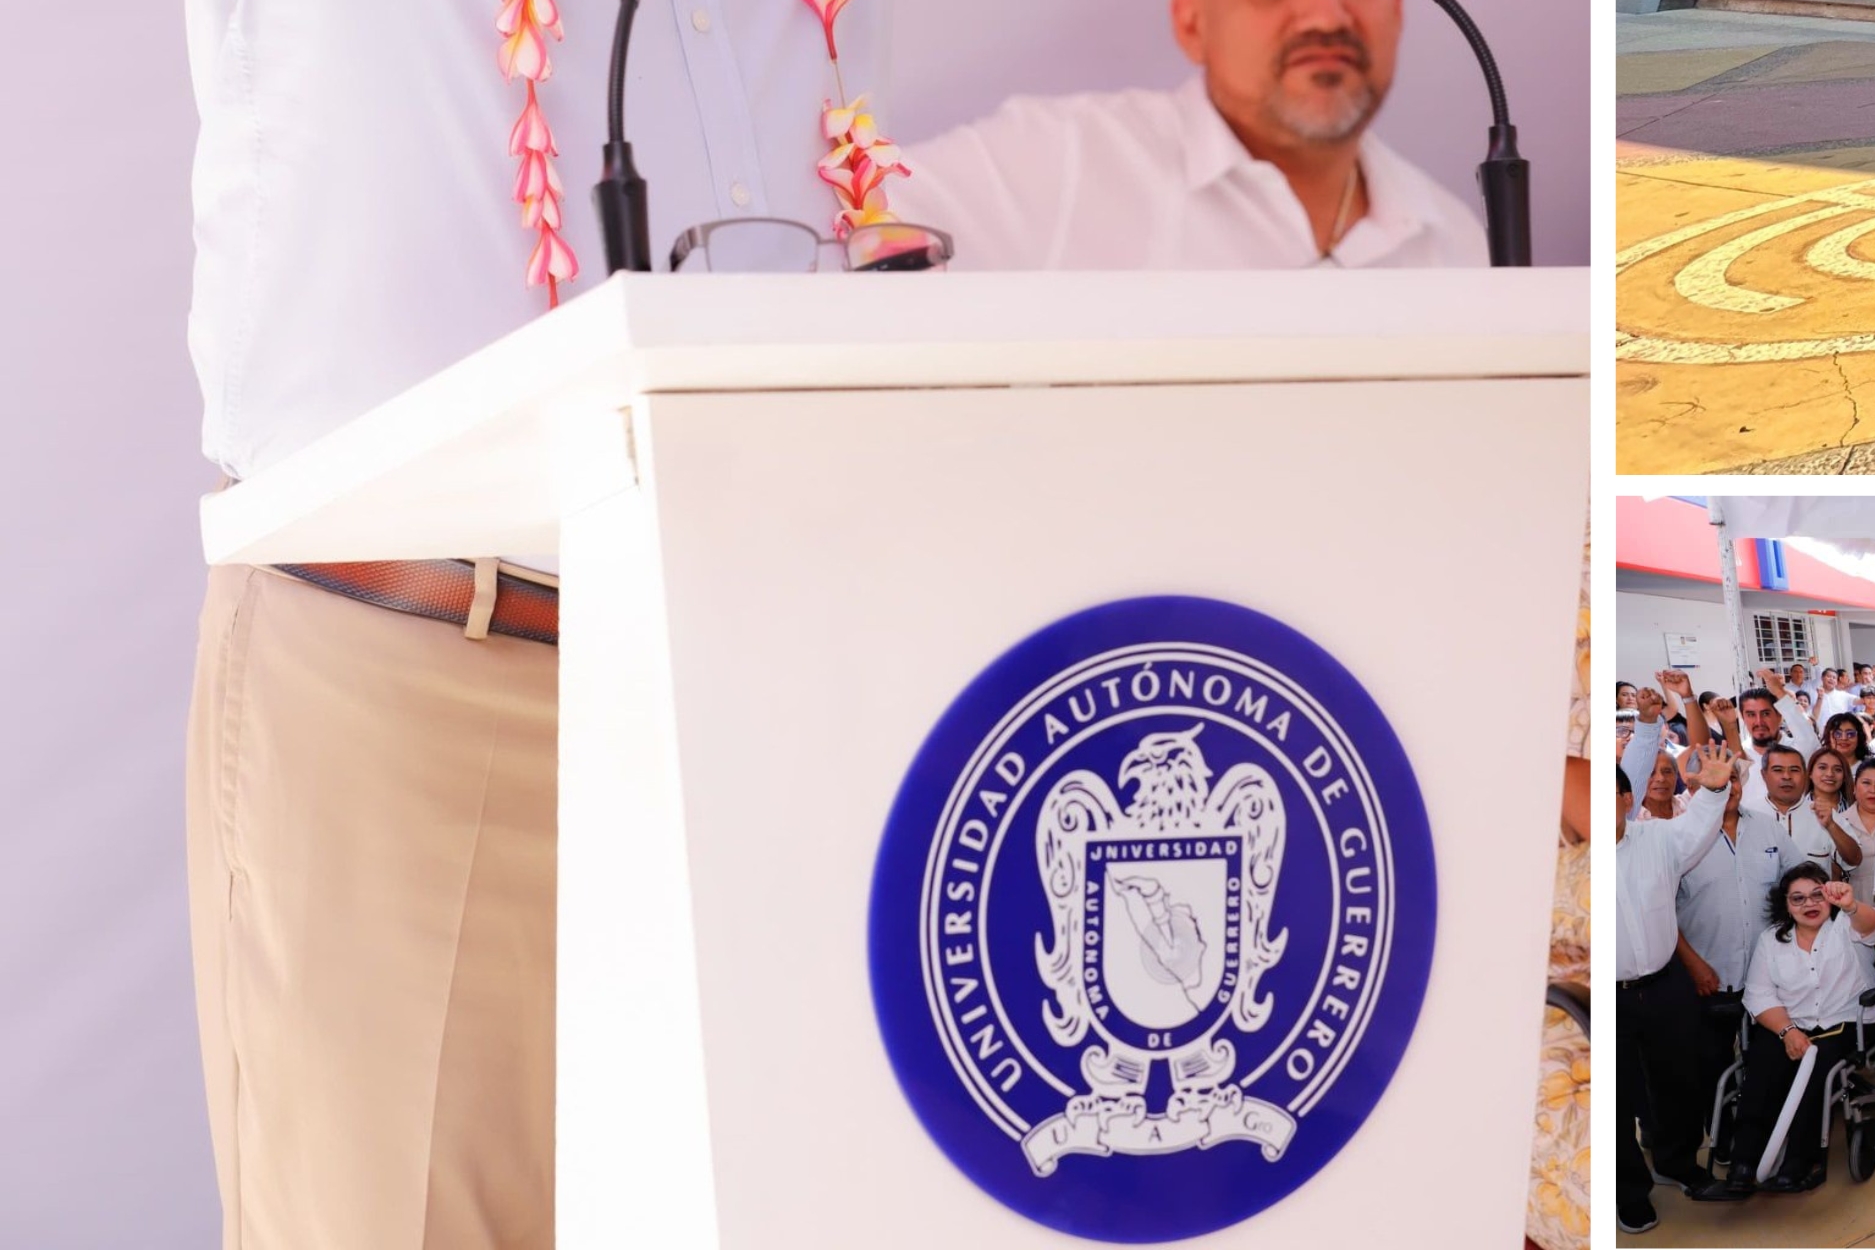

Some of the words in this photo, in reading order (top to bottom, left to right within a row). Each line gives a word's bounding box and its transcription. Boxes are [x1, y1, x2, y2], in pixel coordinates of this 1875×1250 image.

[1044, 662, 1292, 744] AUTÓNOMA
[1304, 745, 1349, 806] DE
[943, 750, 1026, 1094] UNIVERSIDAD
[1084, 881, 1109, 1021] AUTONOMA
[1147, 1033, 1172, 1048] DE
[1217, 877, 1241, 1004] GUERRERO
[1287, 828, 1371, 1082] GUERRERO
[1149, 1125, 1163, 1143] A
